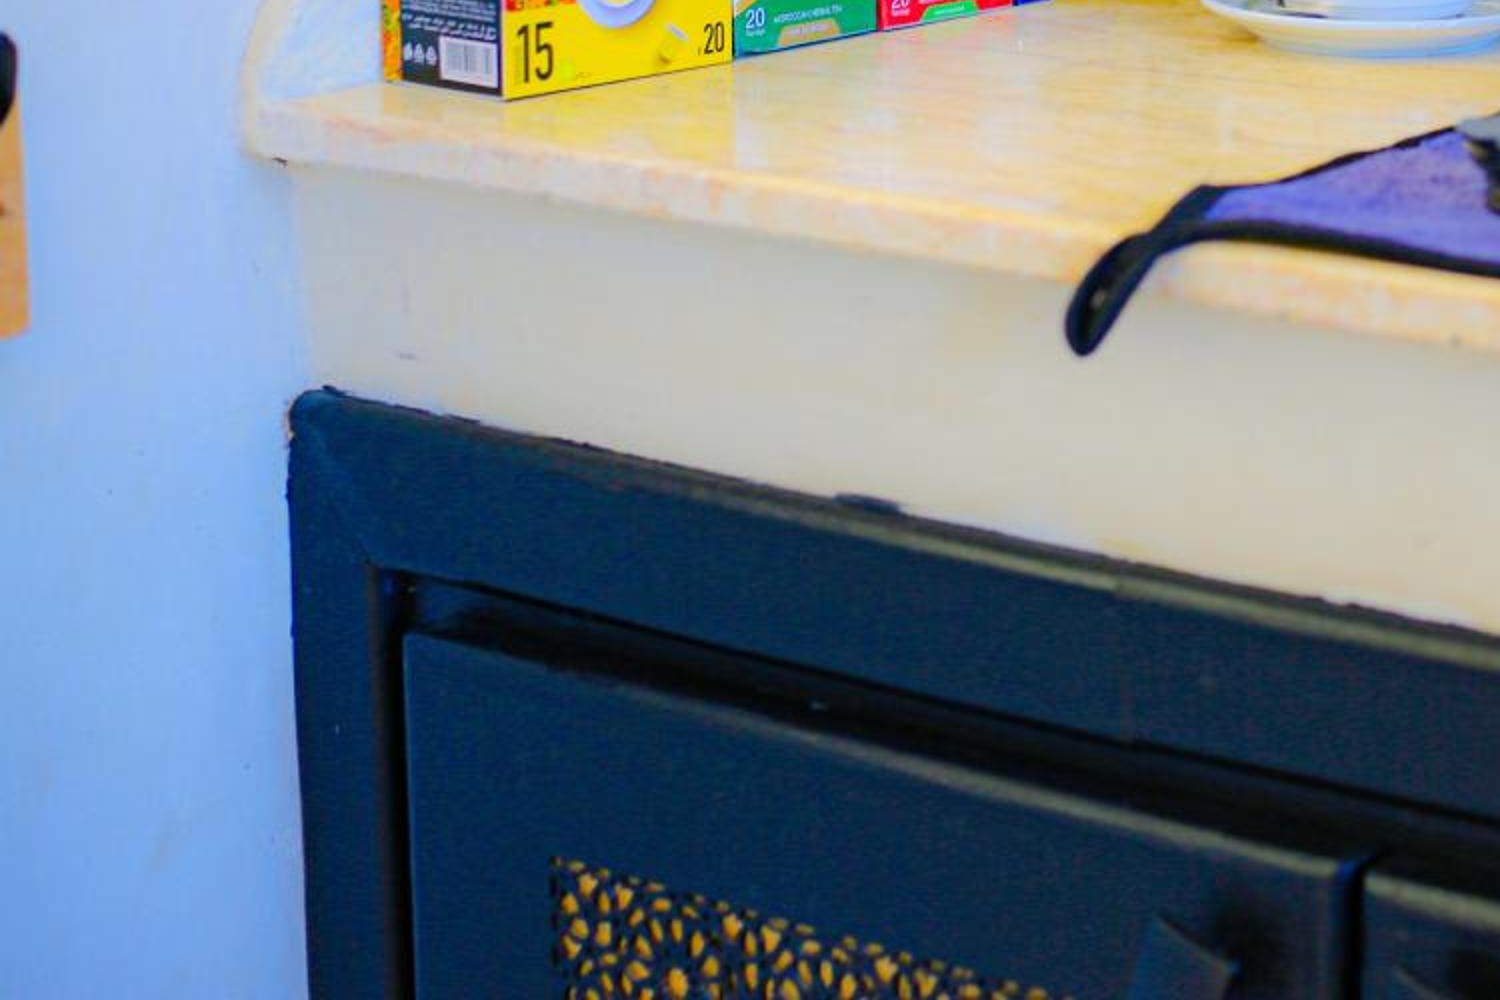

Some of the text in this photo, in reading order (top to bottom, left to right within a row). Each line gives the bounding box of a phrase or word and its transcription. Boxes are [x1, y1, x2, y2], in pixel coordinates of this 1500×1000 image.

[745, 7, 766, 29] 20
[517, 21, 554, 84] 15
[703, 21, 725, 55] 20
